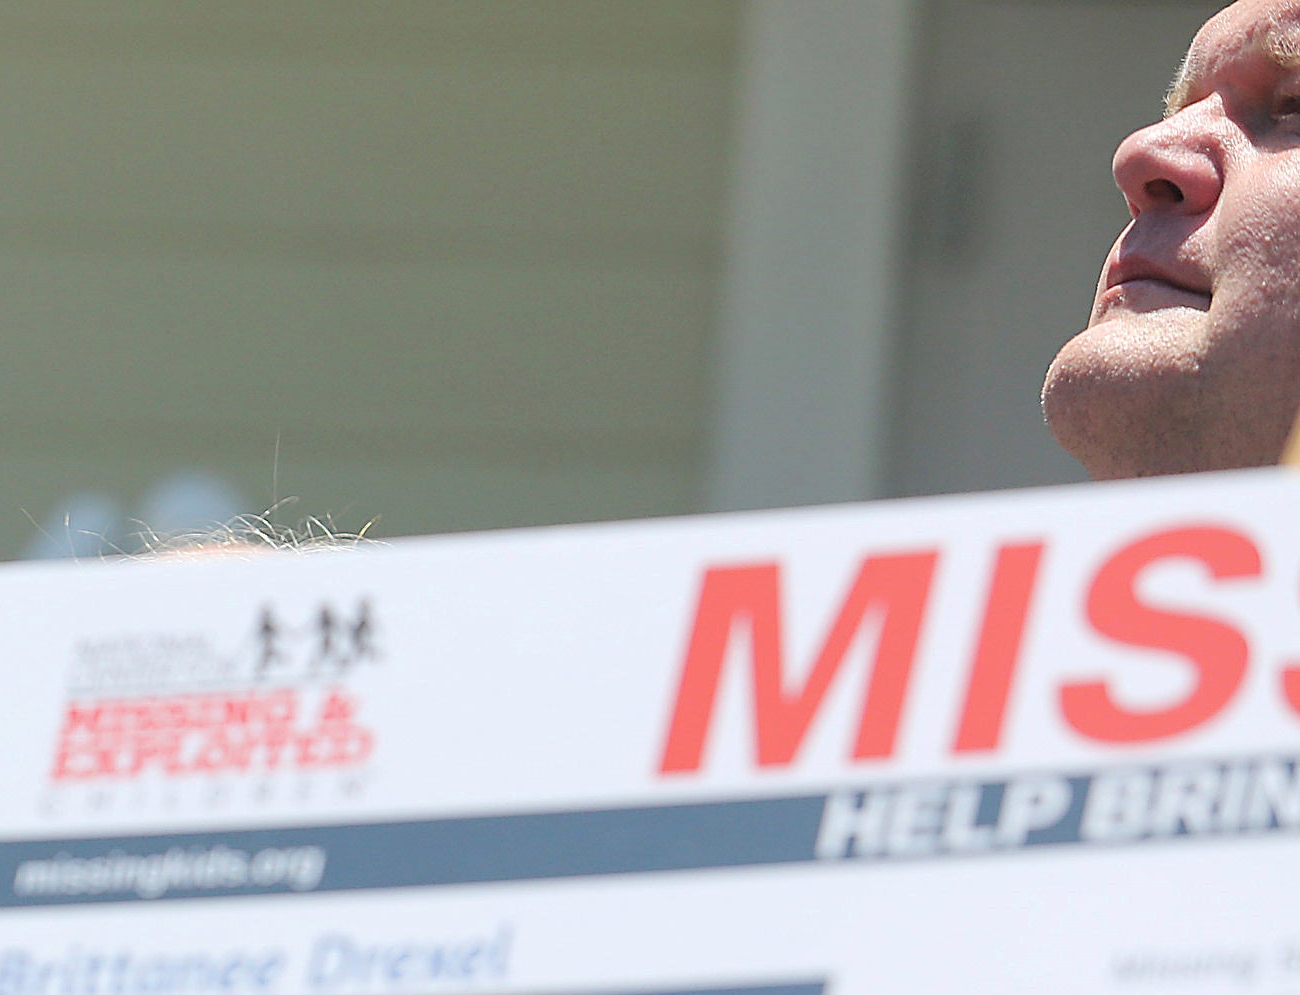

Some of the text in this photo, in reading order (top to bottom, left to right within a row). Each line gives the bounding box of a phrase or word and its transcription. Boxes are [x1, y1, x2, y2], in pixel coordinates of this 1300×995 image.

[656, 521, 1300, 777] MIS
[64, 687, 357, 736] MISSING &
[51, 727, 375, 784] EXPLOITED
[814, 780, 1072, 860] HELP
[14, 844, 326, 899] missingkids.org
[307, 926, 514, 988] Drexel
